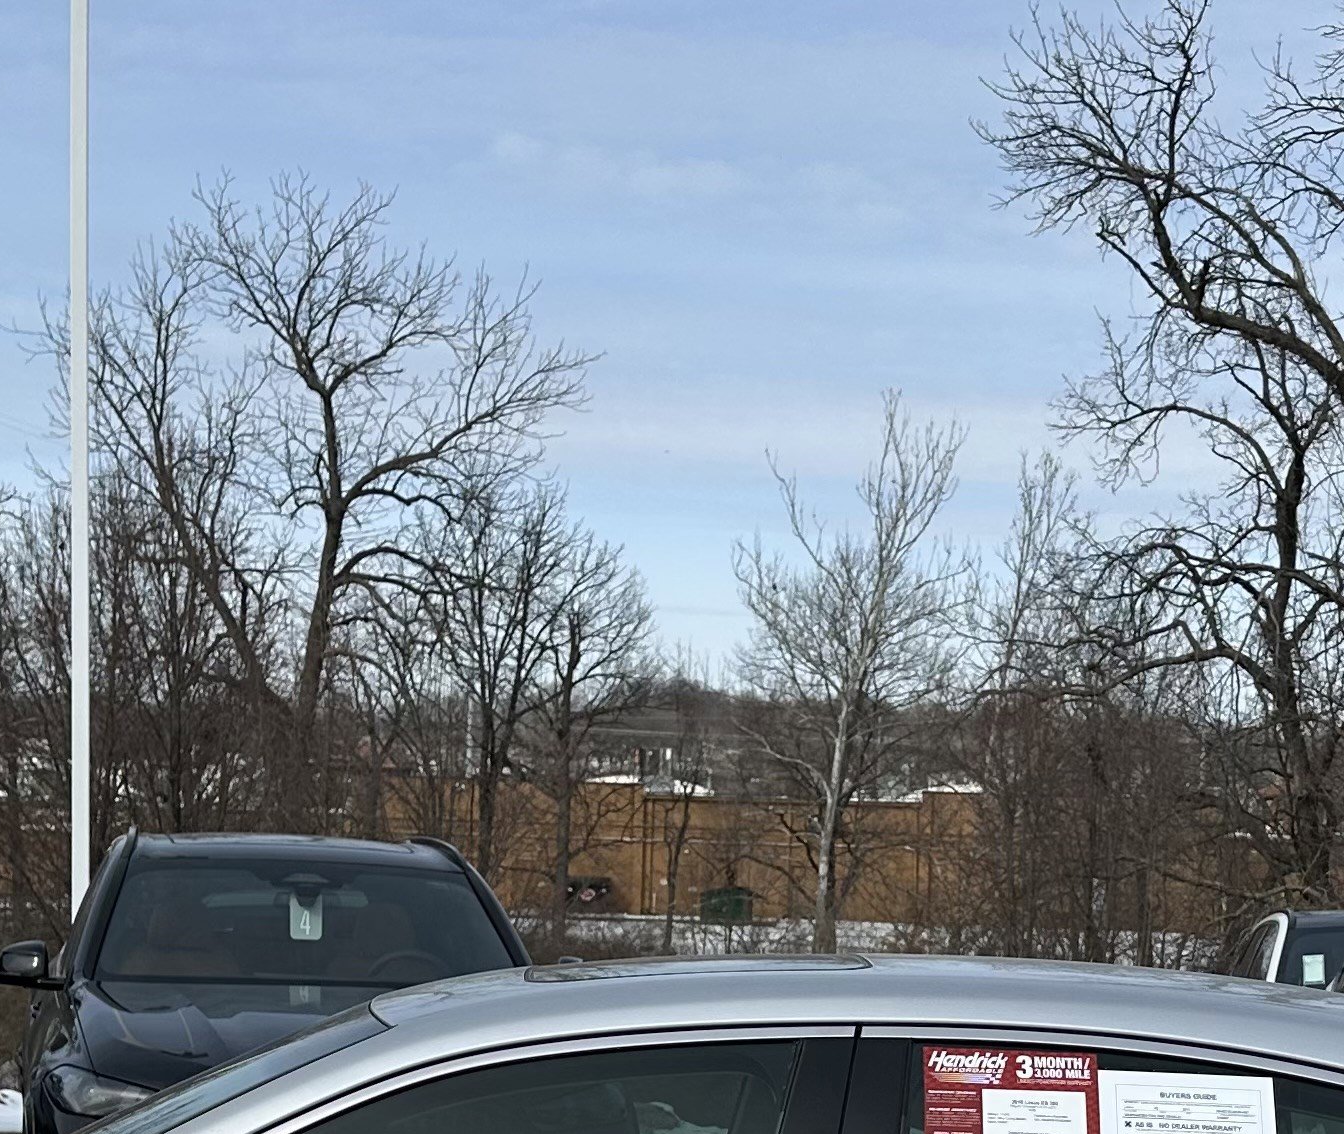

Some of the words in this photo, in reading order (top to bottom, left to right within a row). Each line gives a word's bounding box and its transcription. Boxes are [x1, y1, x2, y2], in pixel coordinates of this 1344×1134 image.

[299, 909, 311, 936] 4
[927, 1050, 1009, 1072] Hendrick
[1015, 1055, 1034, 1079] 3
[1034, 1056, 1091, 1070] MONTH/
[1034, 1069, 1063, 1079] 3,000
[1065, 1069, 1091, 1080] MILE
[1159, 1091, 1191, 1100] BUYERS
[1193, 1093, 1218, 1101] GUIDE
[1171, 1123, 1200, 1131] DEALER
[1201, 1124, 1243, 1132] WARRANTY
